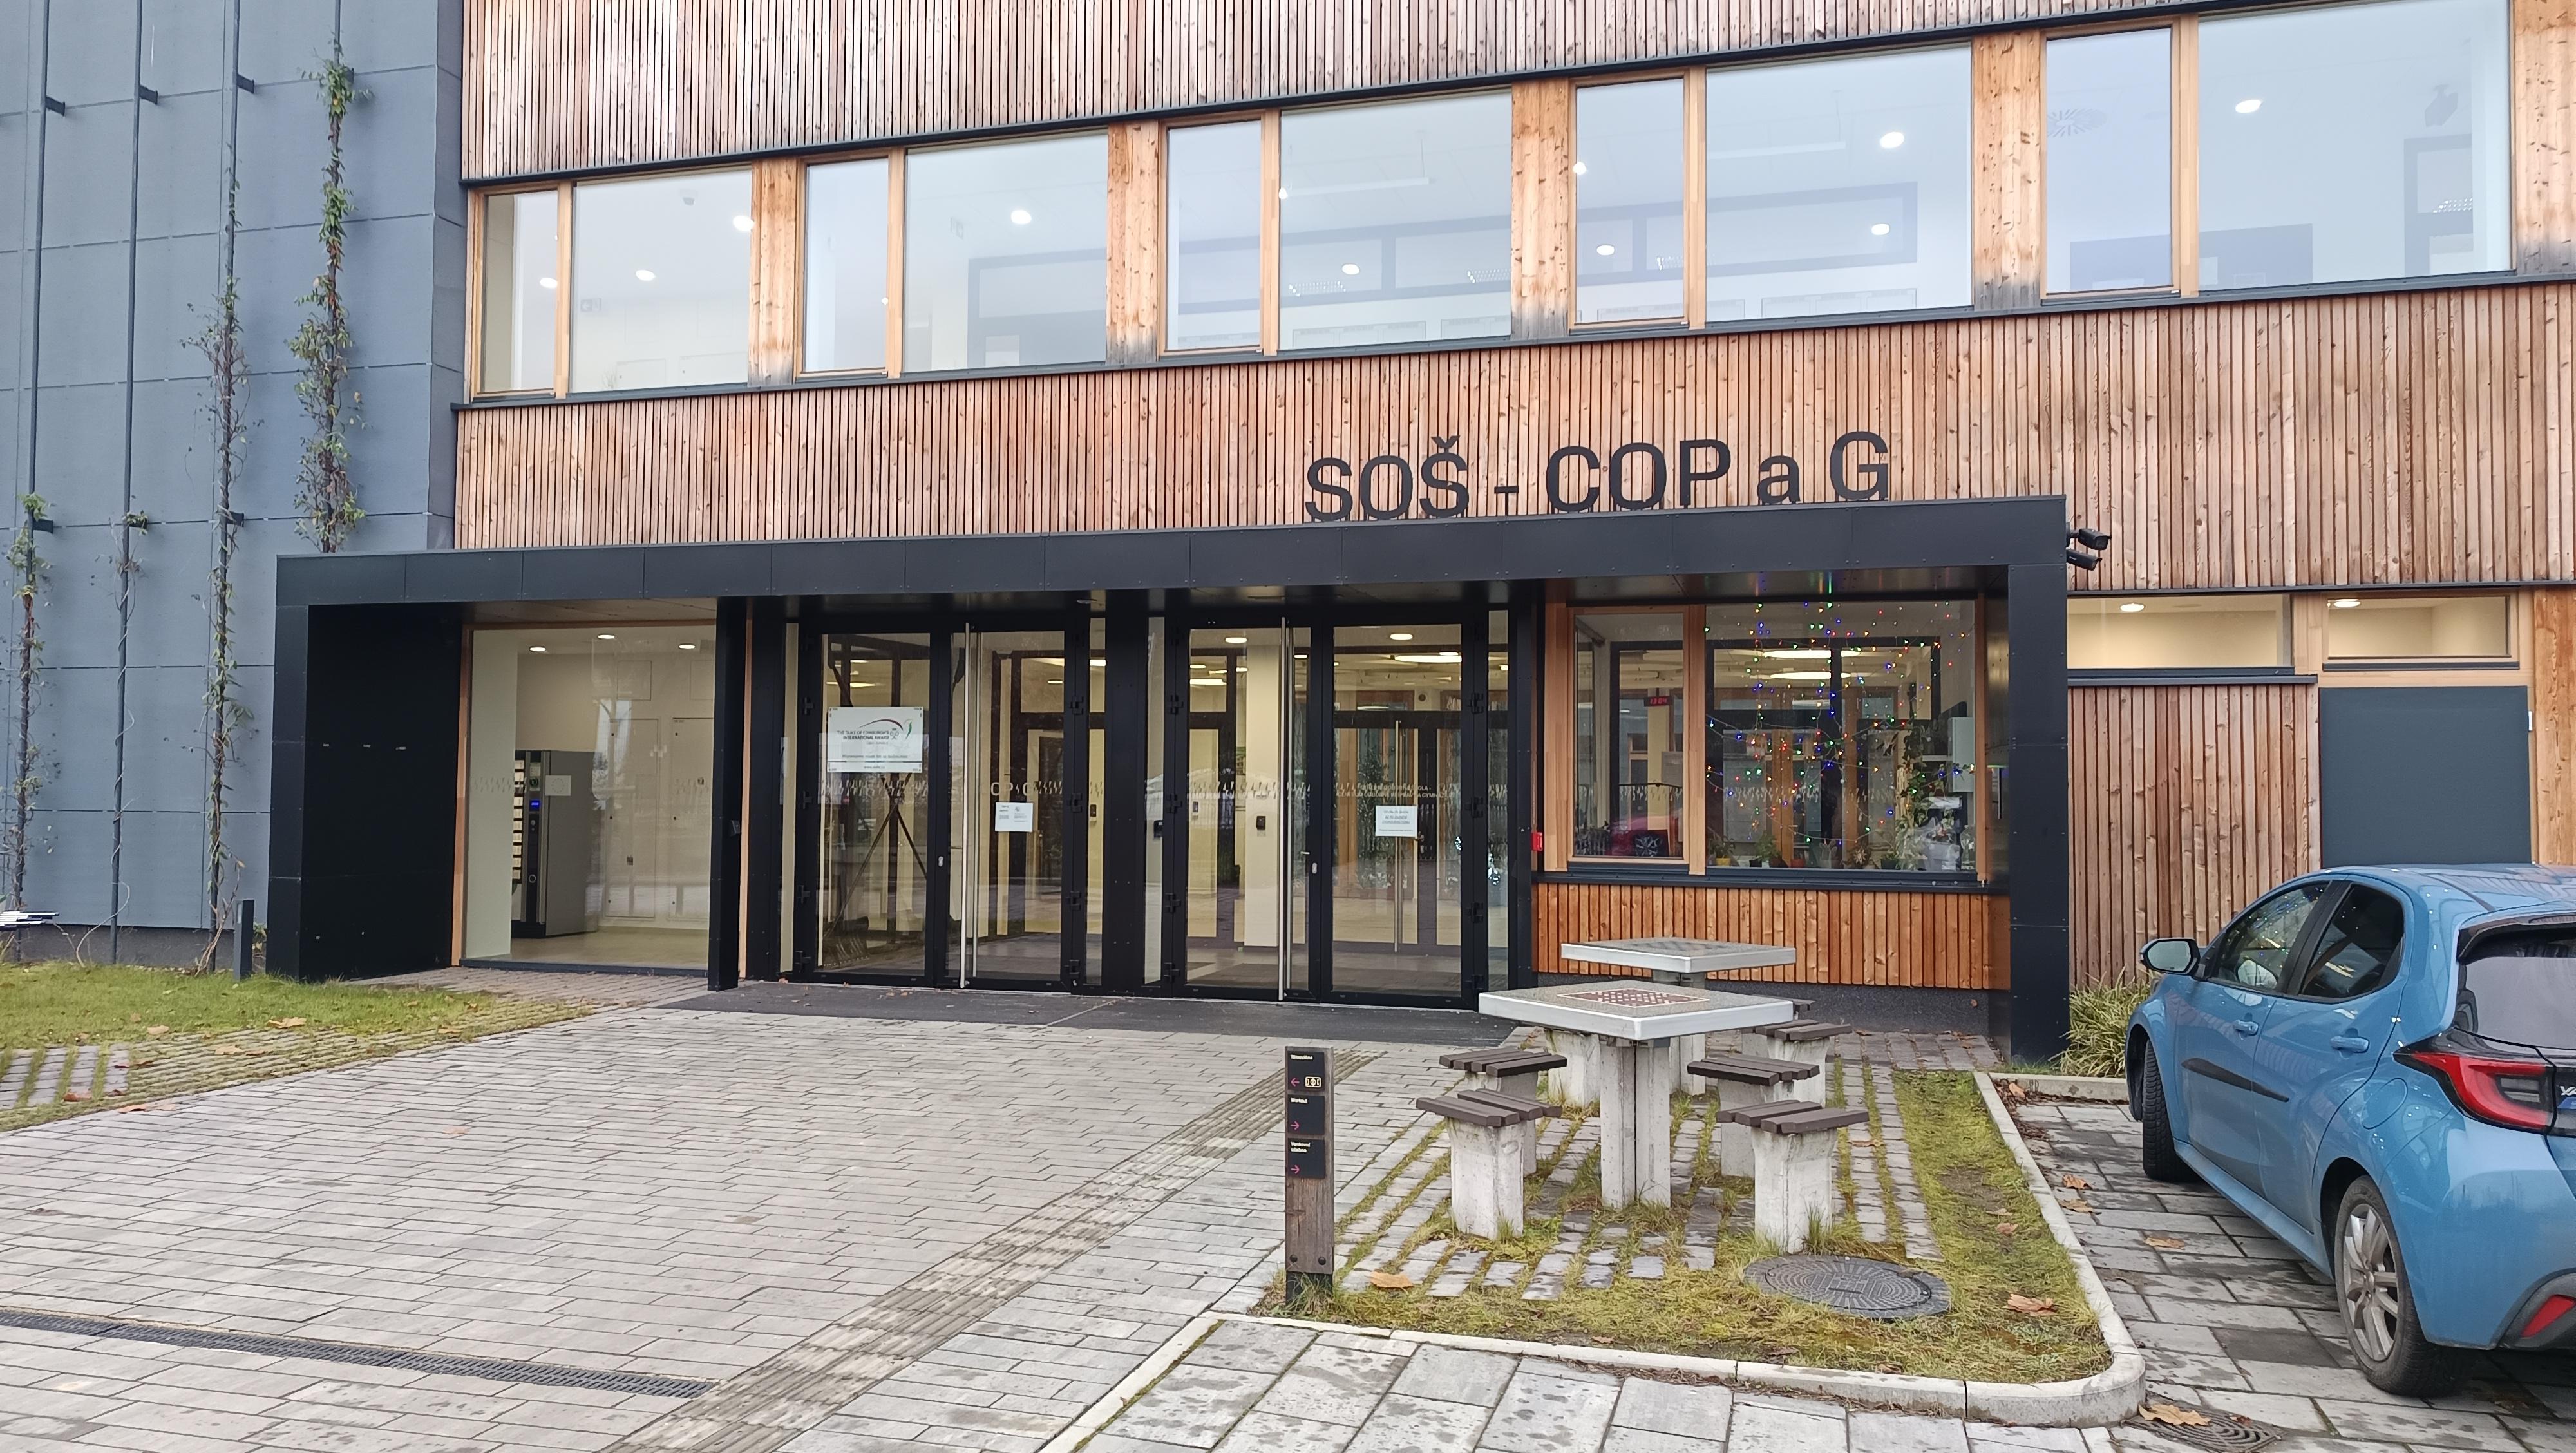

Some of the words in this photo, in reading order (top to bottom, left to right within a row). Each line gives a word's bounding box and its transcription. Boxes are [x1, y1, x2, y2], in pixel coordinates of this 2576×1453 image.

[1305, 435, 1470, 521] SOŠ
[1546, 439, 1731, 513] COP
[1757, 455, 1800, 504] a
[1828, 431, 1889, 500] G
